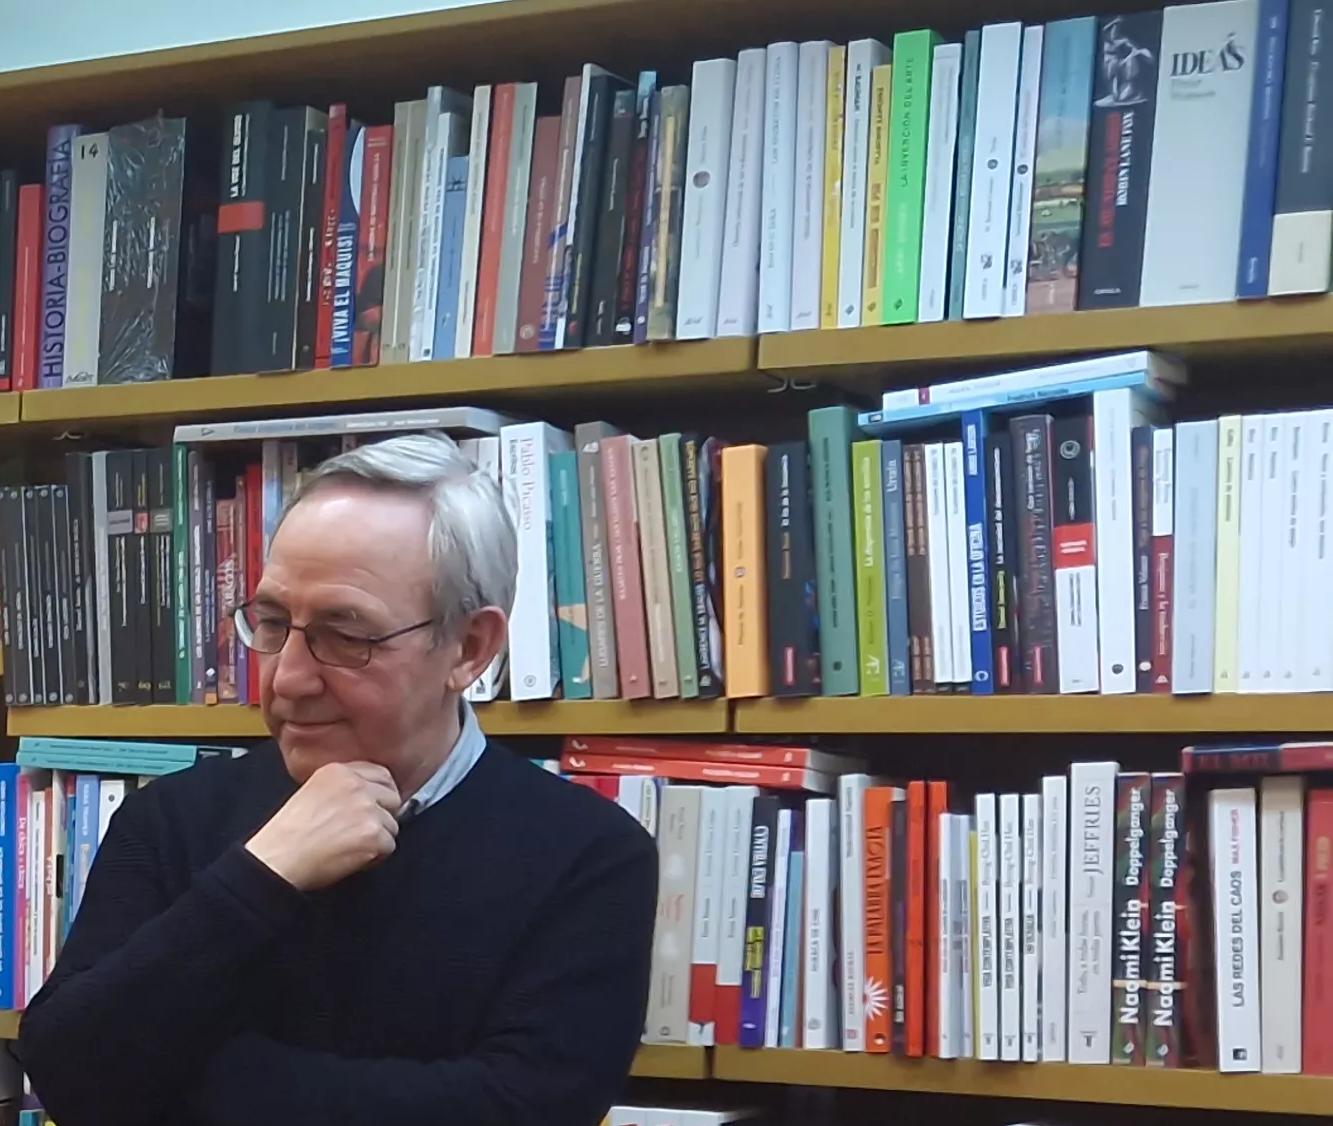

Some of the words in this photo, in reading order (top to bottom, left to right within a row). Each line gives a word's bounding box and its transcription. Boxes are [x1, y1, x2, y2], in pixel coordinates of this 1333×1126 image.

[80, 143, 98, 160] 14
[1083, 786, 1105, 874] JEFFRIES
[1230, 871, 1243, 906] CAOS
[1120, 900, 1141, 950] Klein
[1155, 900, 1175, 953] Klein
[1231, 908, 1243, 933] DEL
[1232, 936, 1244, 979] REDES
[1119, 954, 1141, 1024] Naomi
[1153, 956, 1175, 1026] Naomi
[1231, 983, 1245, 1007] LAS
